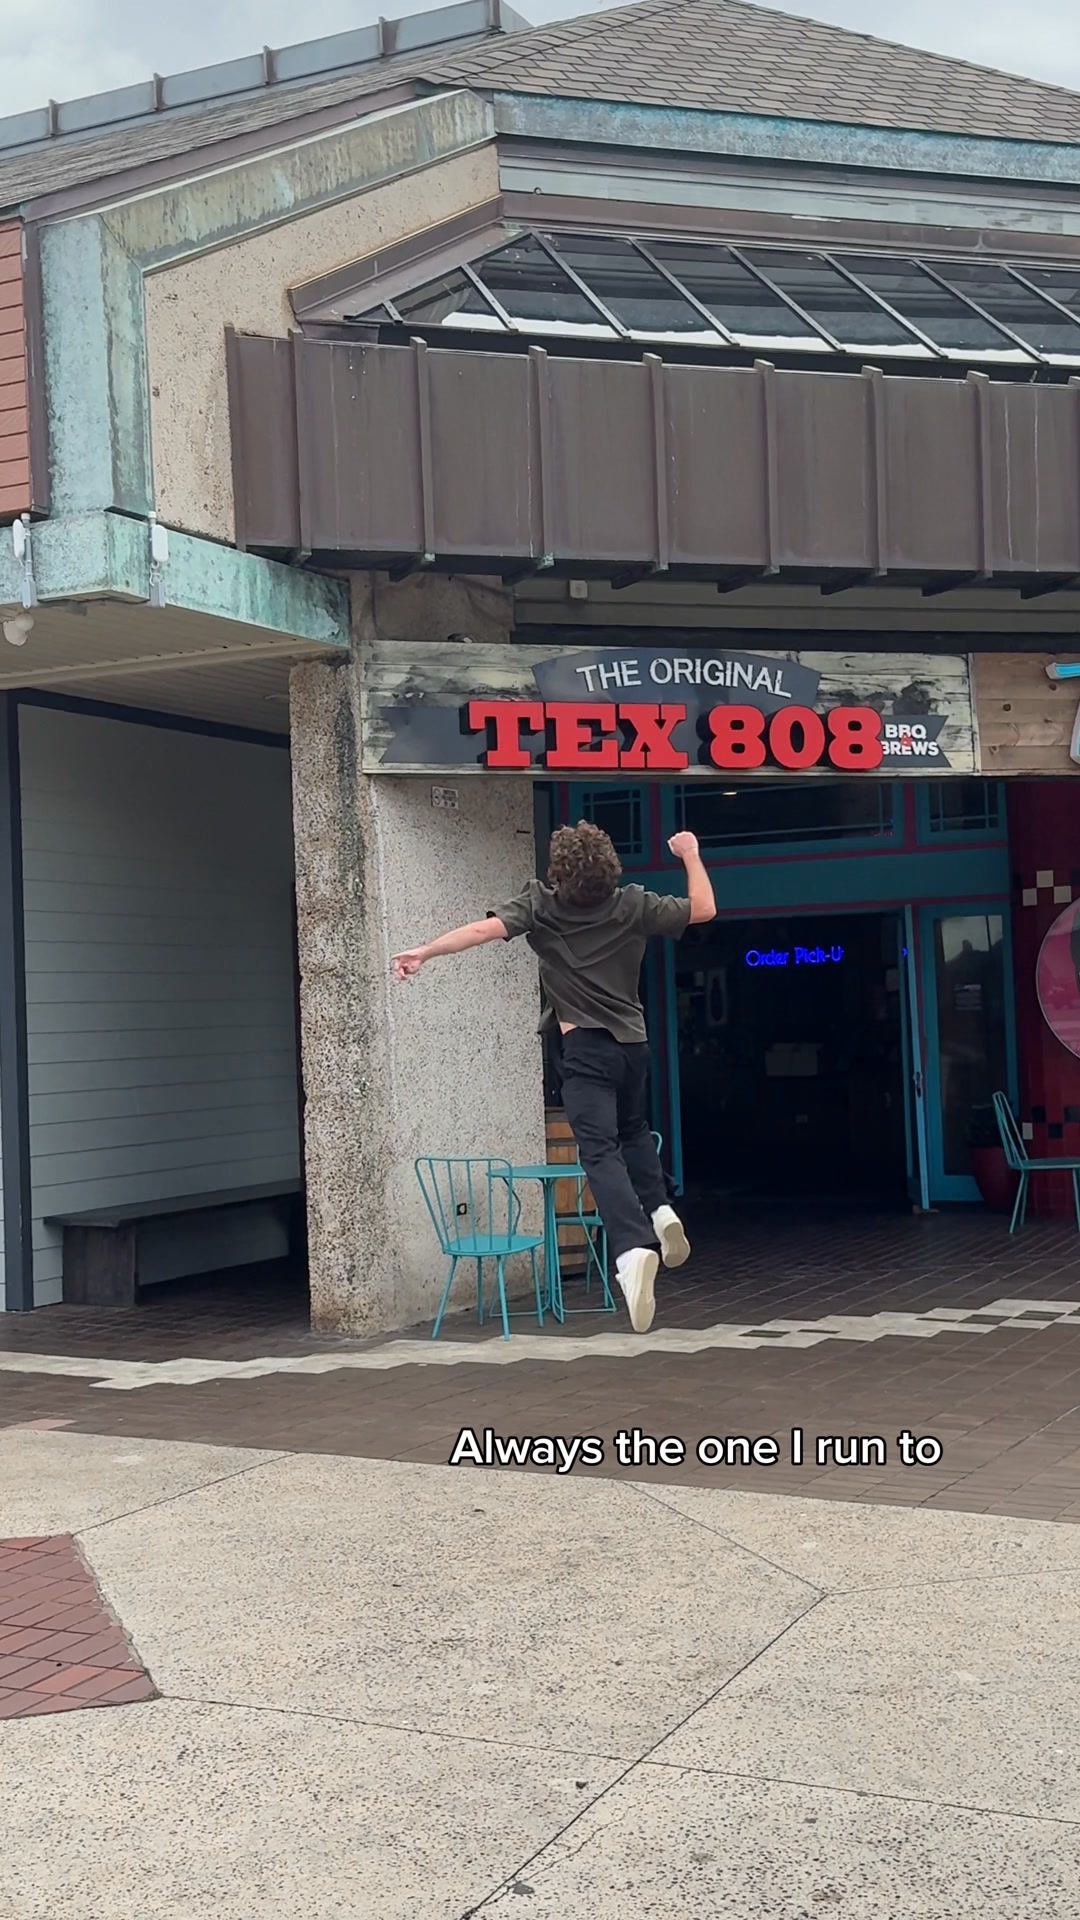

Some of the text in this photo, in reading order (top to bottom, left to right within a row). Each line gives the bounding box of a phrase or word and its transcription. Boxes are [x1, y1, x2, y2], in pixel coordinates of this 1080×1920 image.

[576, 658, 792, 698] THE ORIGINAL
[467, 700, 884, 769] TEX 808
[884, 724, 927, 740] BBQ
[881, 741, 939, 756] BREWS
[745, 949, 789, 966] Order
